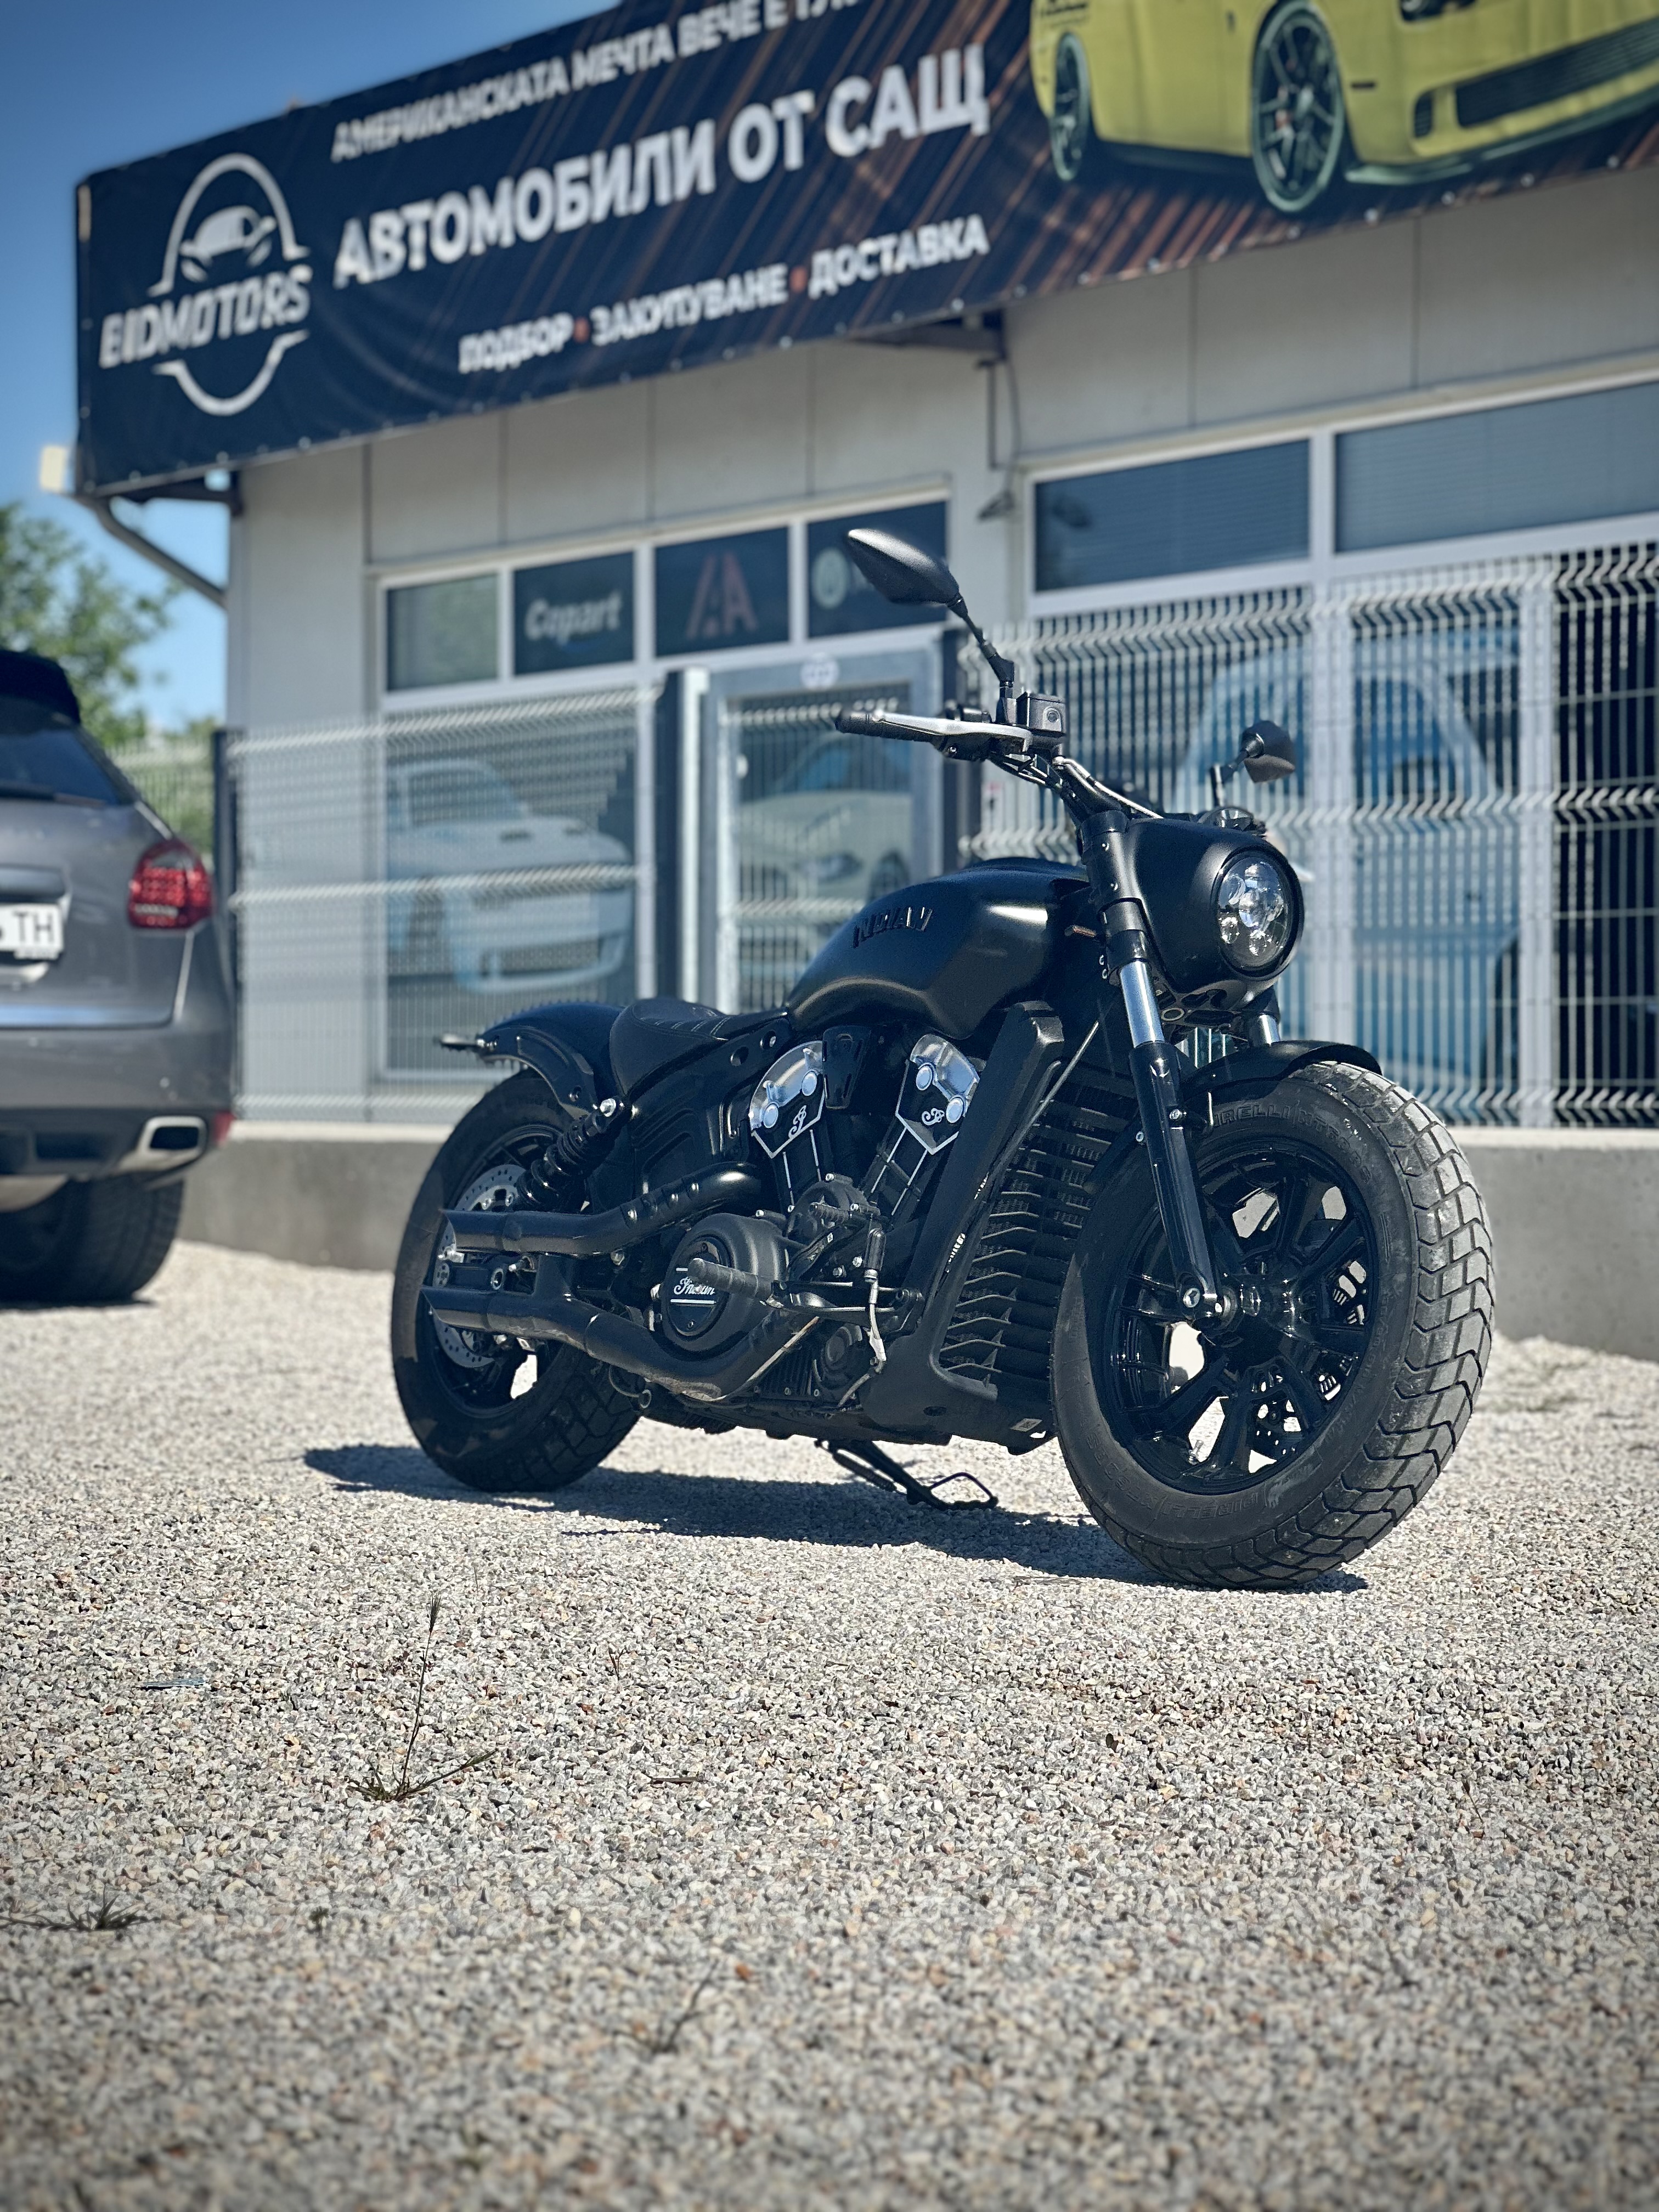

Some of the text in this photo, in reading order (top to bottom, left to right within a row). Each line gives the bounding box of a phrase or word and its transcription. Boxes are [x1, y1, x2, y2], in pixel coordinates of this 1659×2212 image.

[331, 57, 571, 163] АМЕРИКАНСКАТА
[571, 24, 675, 90] МЕЧТА
[677, 0, 760, 57] ВЕЧЕ
[333, 42, 990, 289] АВТОМОБИЛИ ОТ САЩ
[99, 264, 313, 369] EIDMOTORS
[458, 213, 990, 374] ПОДБОР ЗАКУПУВАНЕ ДОСТАВКА
[12, 910, 54, 944] TH
[1211, 1103, 1290, 1129] IRELLI
